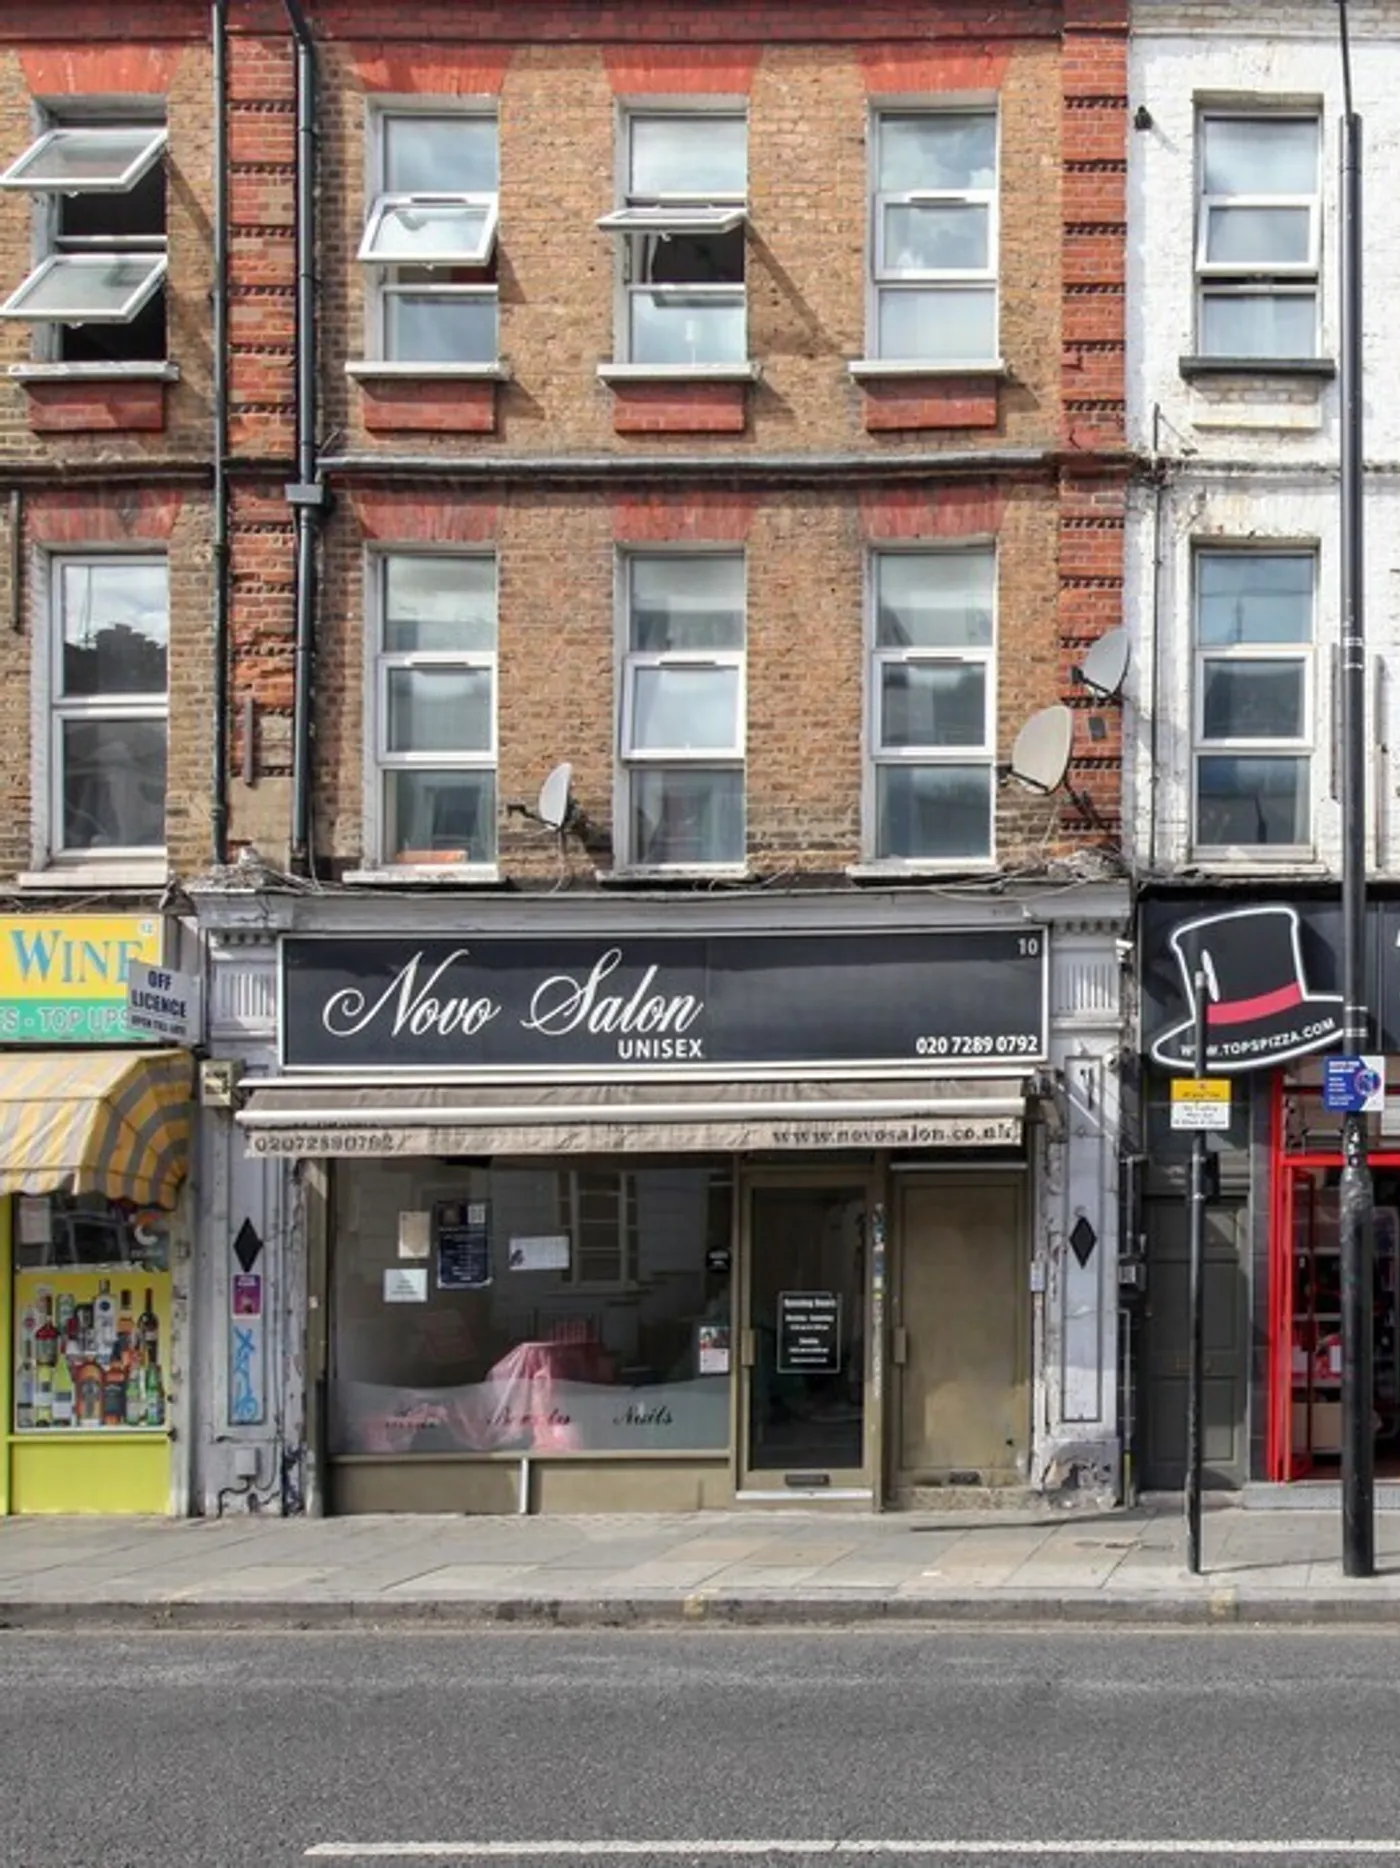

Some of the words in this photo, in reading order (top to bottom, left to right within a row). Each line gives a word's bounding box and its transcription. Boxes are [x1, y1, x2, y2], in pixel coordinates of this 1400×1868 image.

[1018, 938, 1039, 956] 10
[147, 970, 172, 991] OFF
[322, 949, 502, 1036] Novo
[520, 948, 704, 1035] Salon
[131, 989, 187, 1018] LICENCE
[37, 1006, 84, 1034] TOP
[618, 1039, 703, 1059] UNISEX
[916, 1036, 948, 1054] 020
[951, 1036, 993, 1054] 7289
[995, 1034, 1038, 1053] 0792
[772, 1124, 1012, 1144] www.novosalon.co.uk
